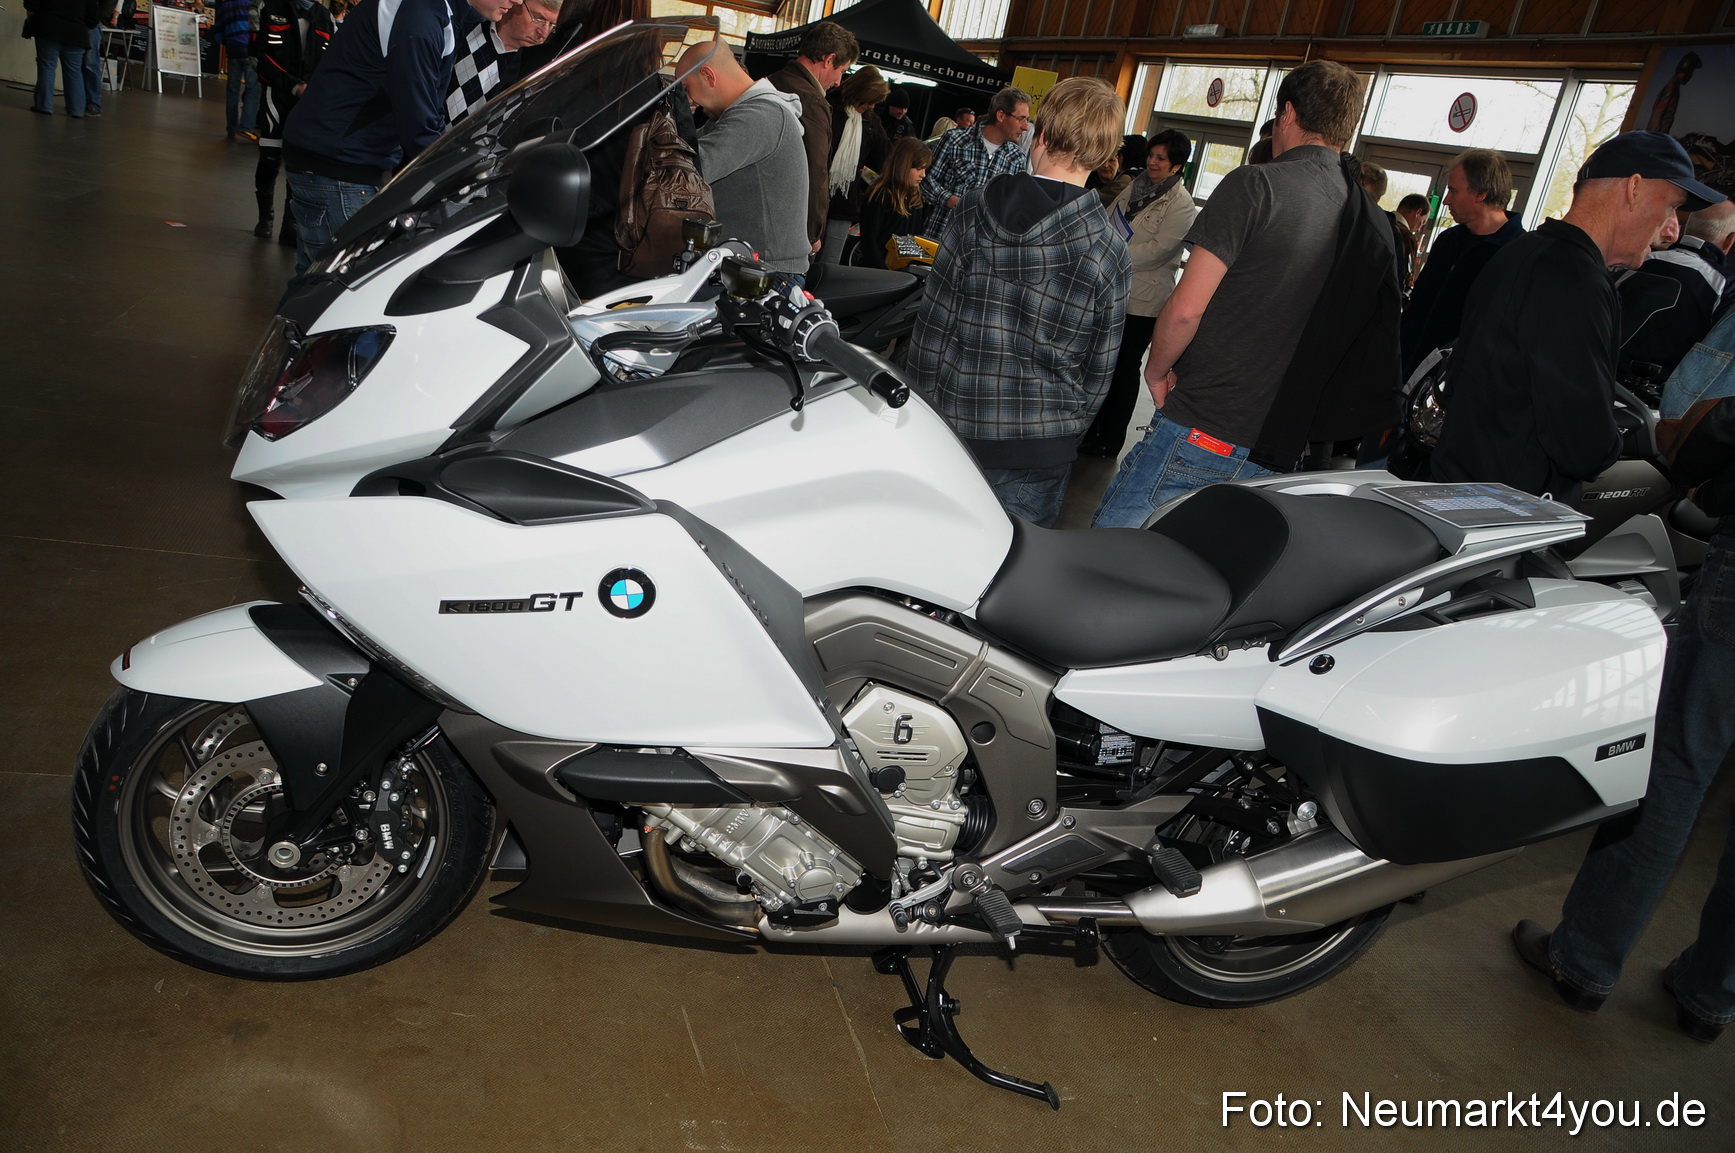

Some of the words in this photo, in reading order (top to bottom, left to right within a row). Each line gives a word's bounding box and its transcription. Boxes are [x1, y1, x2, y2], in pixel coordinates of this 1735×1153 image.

[893, 713, 914, 744] 6
[1607, 739, 1636, 757] BMW
[725, 808, 750, 834] BMW
[380, 824, 395, 850] BMW
